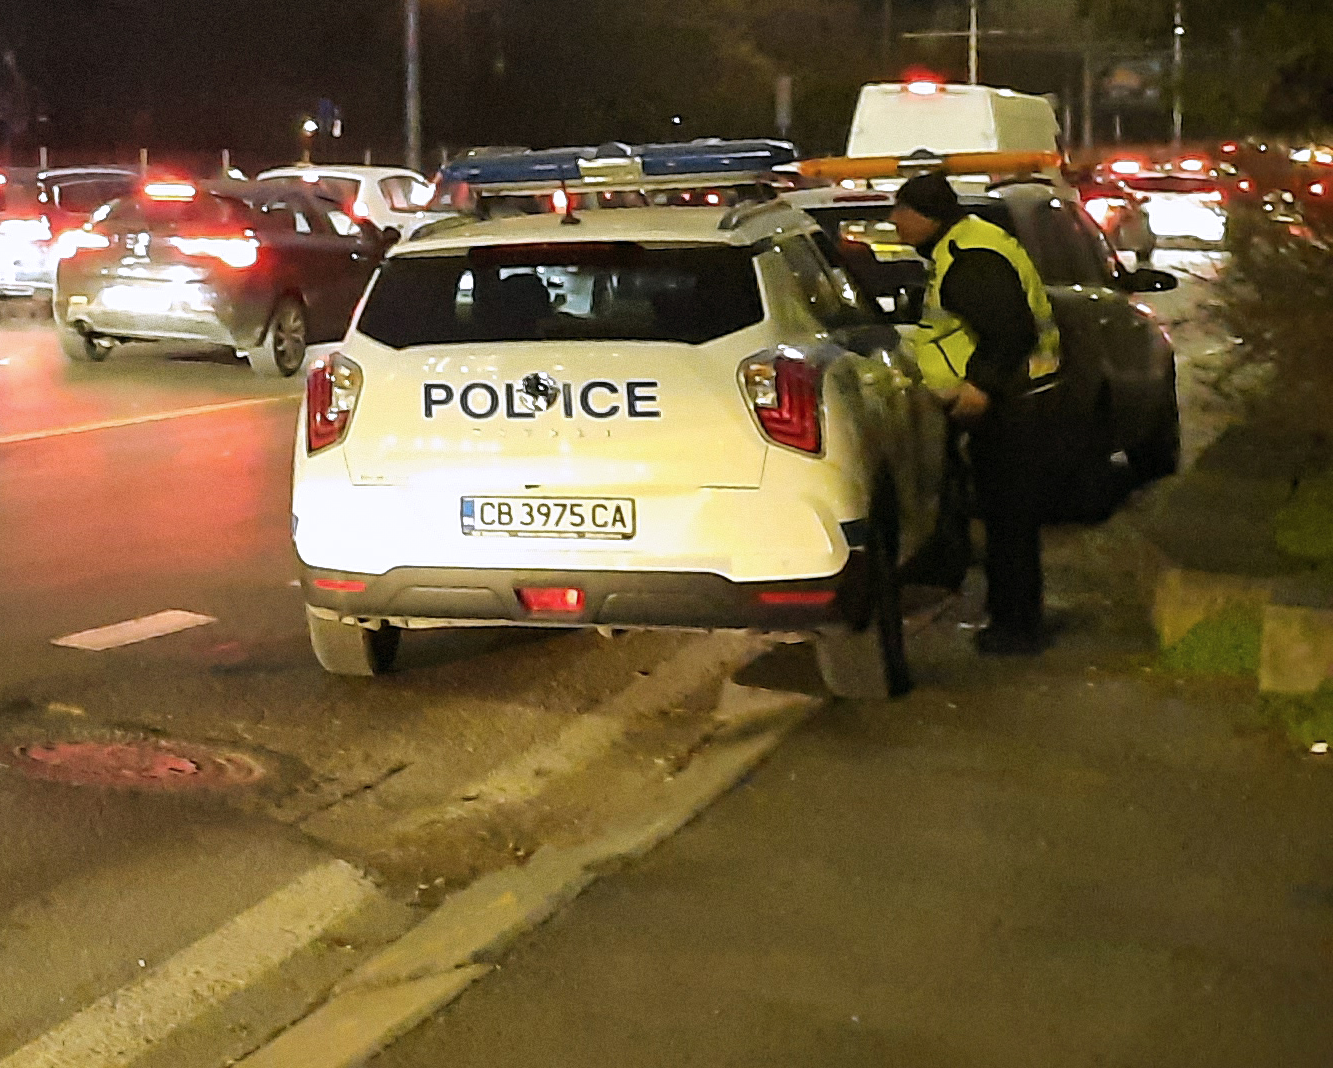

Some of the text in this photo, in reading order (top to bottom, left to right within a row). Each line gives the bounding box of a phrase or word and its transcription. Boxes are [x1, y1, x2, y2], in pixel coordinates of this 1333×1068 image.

[423, 380, 662, 419] POLICE
[480, 502, 627, 528] CB 3975 CA
